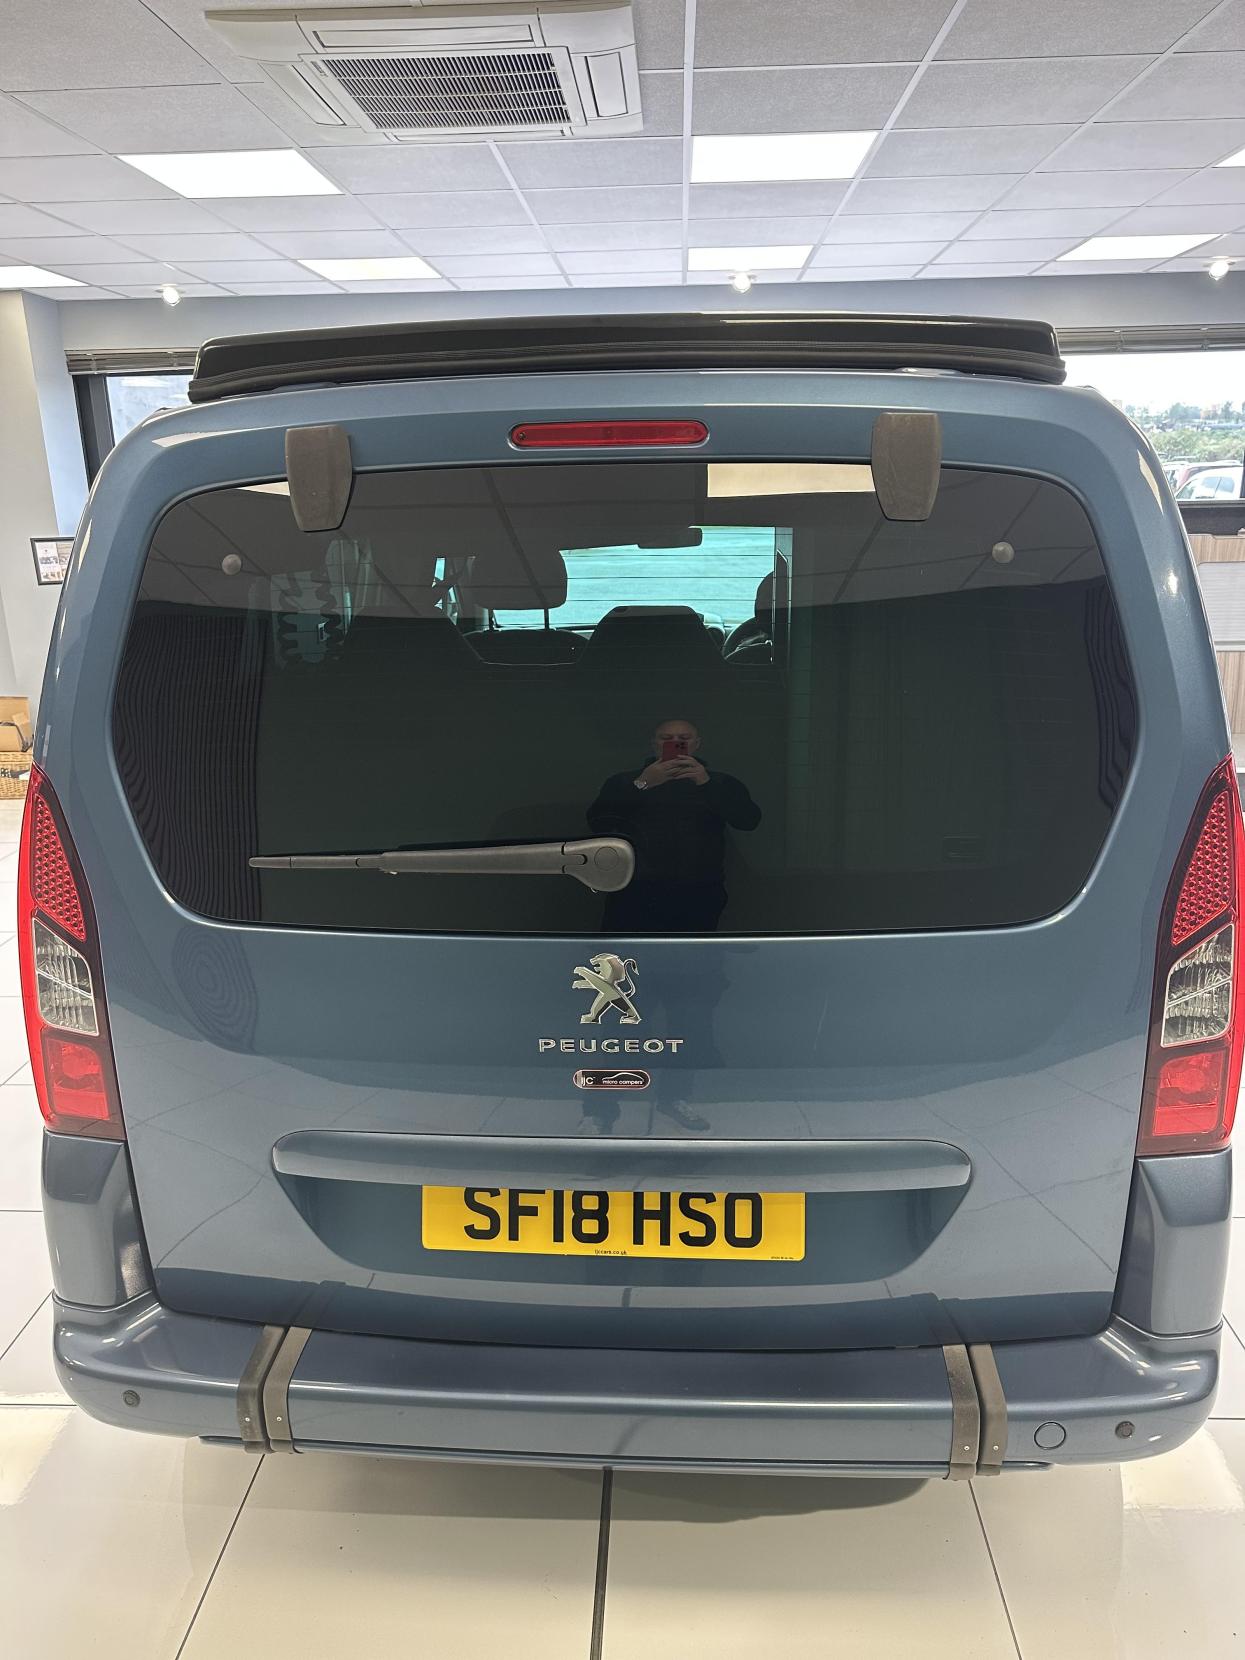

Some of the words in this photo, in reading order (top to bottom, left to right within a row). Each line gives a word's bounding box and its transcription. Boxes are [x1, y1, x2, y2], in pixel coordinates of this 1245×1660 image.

[538, 1038, 684, 1053] PEUGEOT
[464, 1187, 609, 1244] SF18
[633, 1191, 762, 1249] HSO
